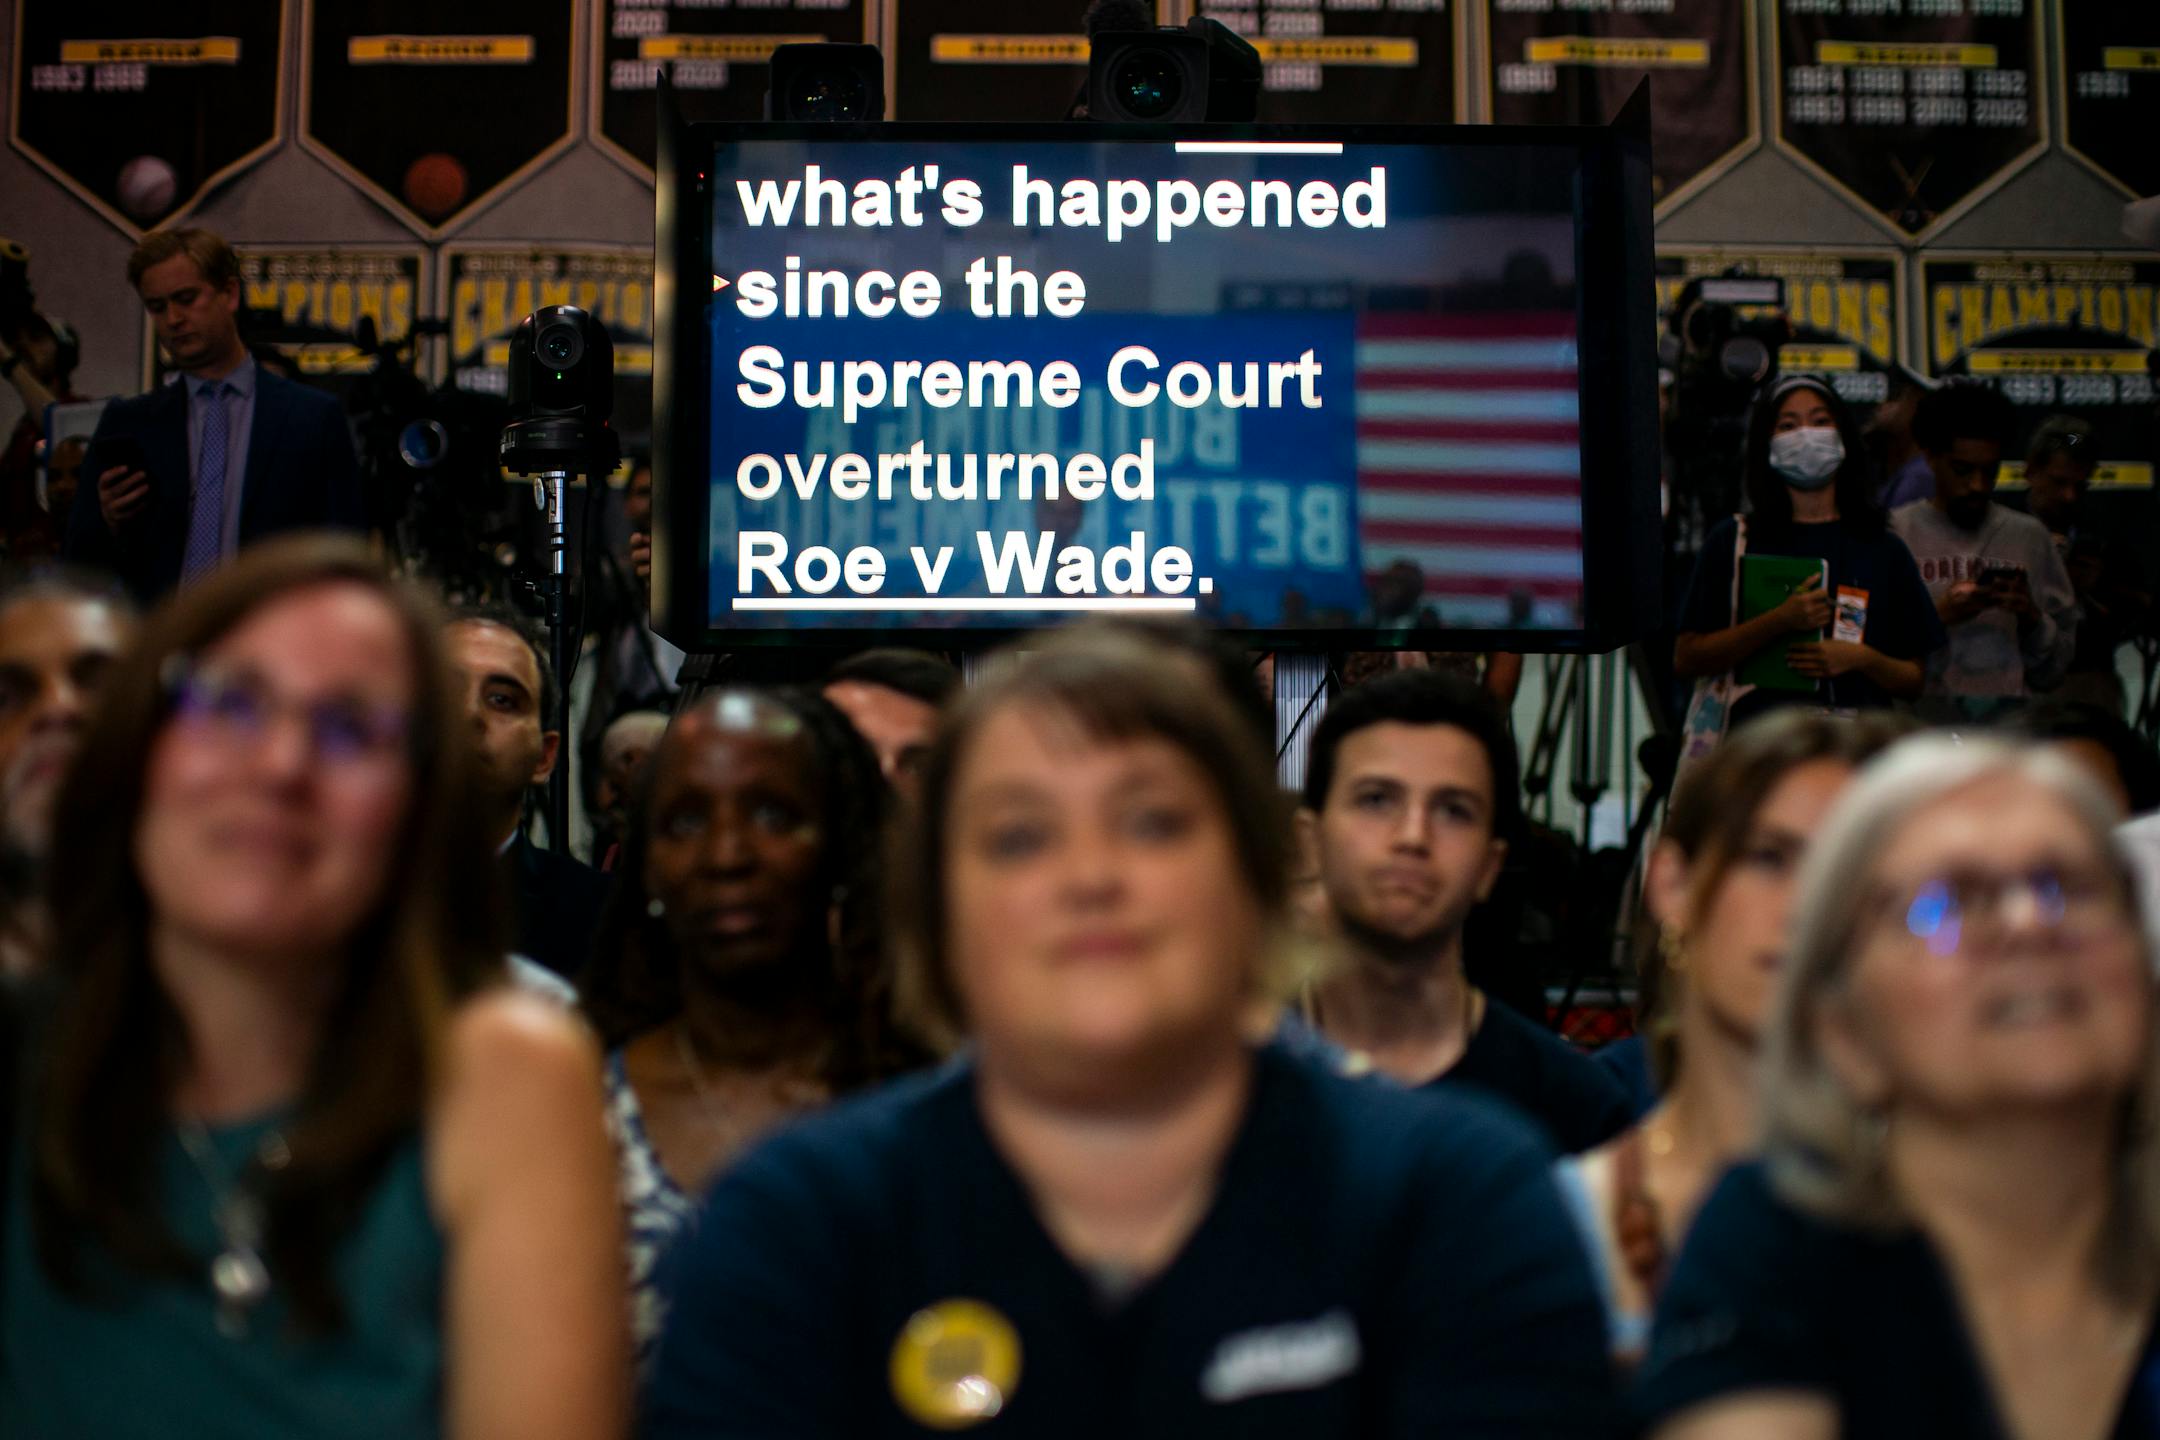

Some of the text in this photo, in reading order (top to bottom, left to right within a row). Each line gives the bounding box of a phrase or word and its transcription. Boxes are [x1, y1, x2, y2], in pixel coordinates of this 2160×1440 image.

[737, 166, 1385, 241] what's happened
[244, 275, 412, 344] MPIONS
[452, 274, 653, 364] CHAMPIO
[737, 257, 1085, 316] since the
[1934, 280, 2160, 370] CHAMPION
[738, 347, 1321, 422] Supreme Court
[738, 439, 1154, 500] overturned
[739, 531, 1212, 593] Roe v Wade.
